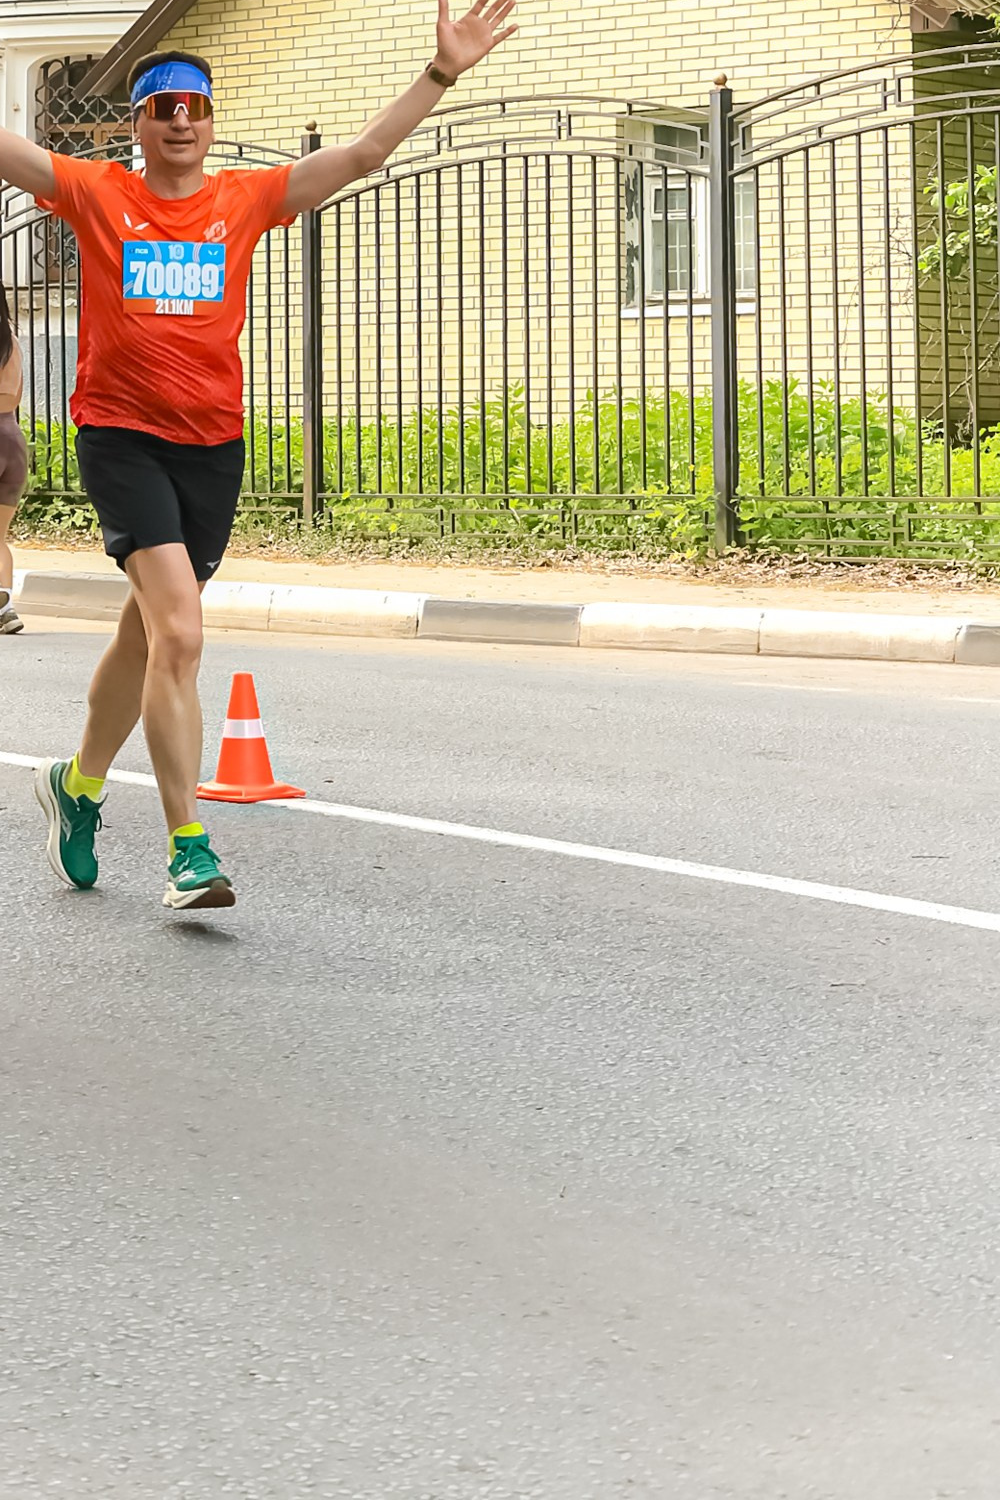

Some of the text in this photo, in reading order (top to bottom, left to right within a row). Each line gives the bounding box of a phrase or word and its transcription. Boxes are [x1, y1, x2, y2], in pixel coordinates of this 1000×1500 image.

[168, 244, 185, 260] 10
[129, 261, 219, 298] 70089
[155, 298, 193, 315] 21.1KM
